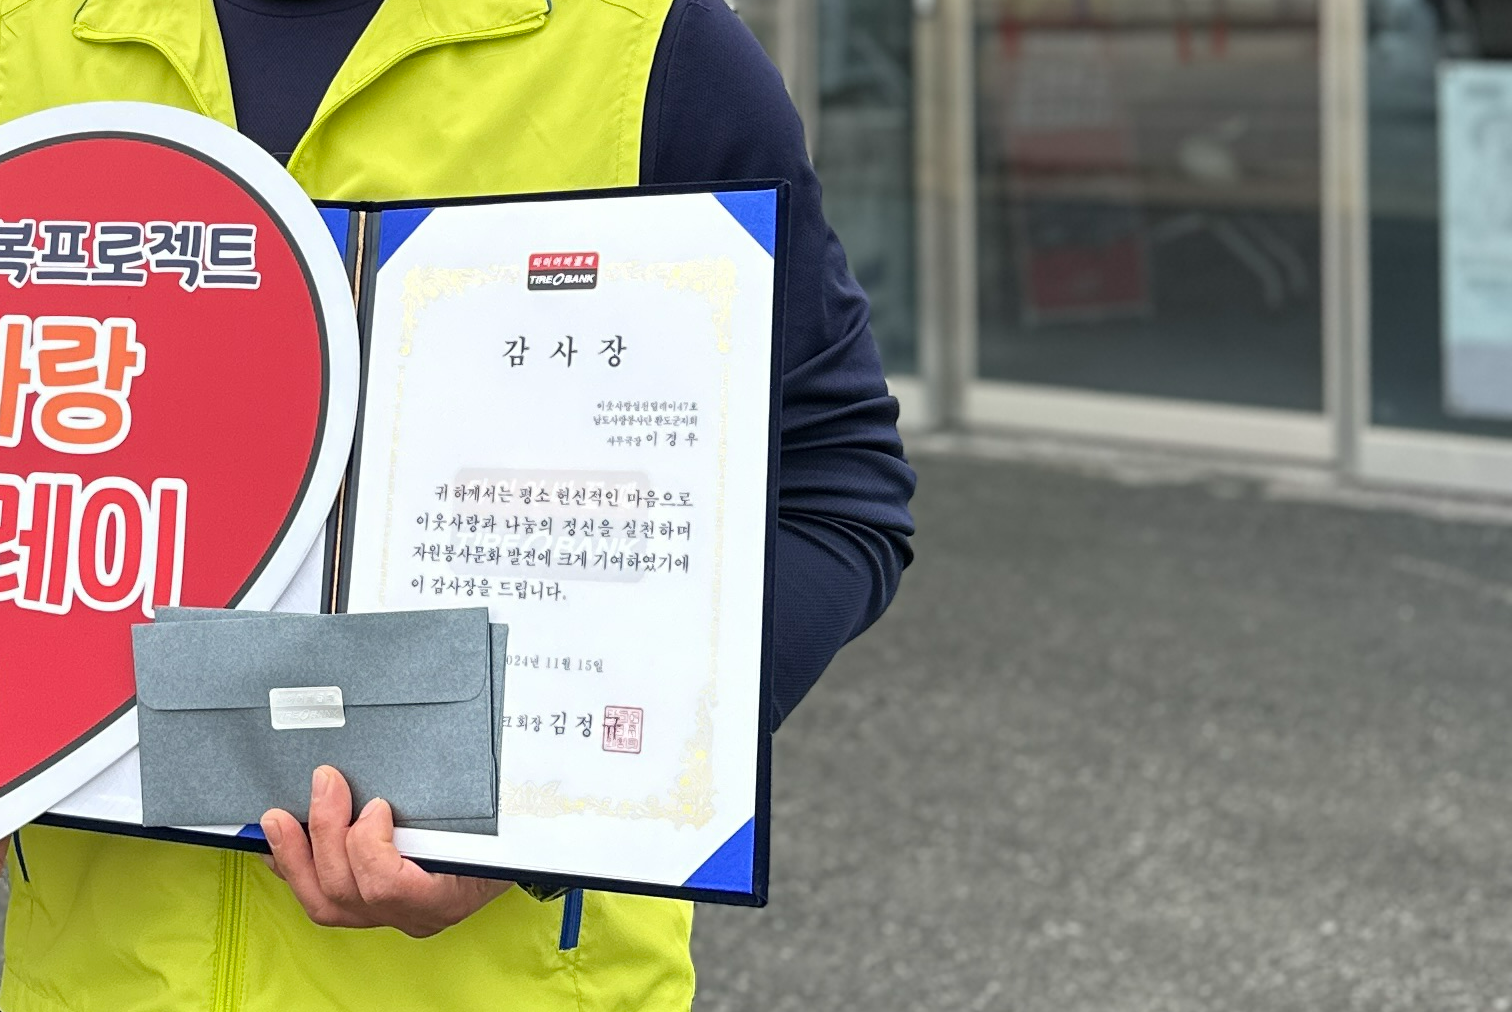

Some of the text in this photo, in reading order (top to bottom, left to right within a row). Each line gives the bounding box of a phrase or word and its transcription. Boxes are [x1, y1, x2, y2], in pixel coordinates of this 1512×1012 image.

[519, 486, 550, 504] 평소
[556, 487, 618, 507] 헌신적인
[628, 489, 693, 508] 마음으로
[416, 511, 691, 540] 이웃사랑과 나눔의 정신을 실천하며
[412, 543, 689, 573] 자원봉사문화 발전에 크게 기여하였기에
[411, 574, 567, 601] 이 감사장을 드립니다.
[506, 654, 603, 673] 024년 11월 15일
[516, 714, 543, 732] 회장
